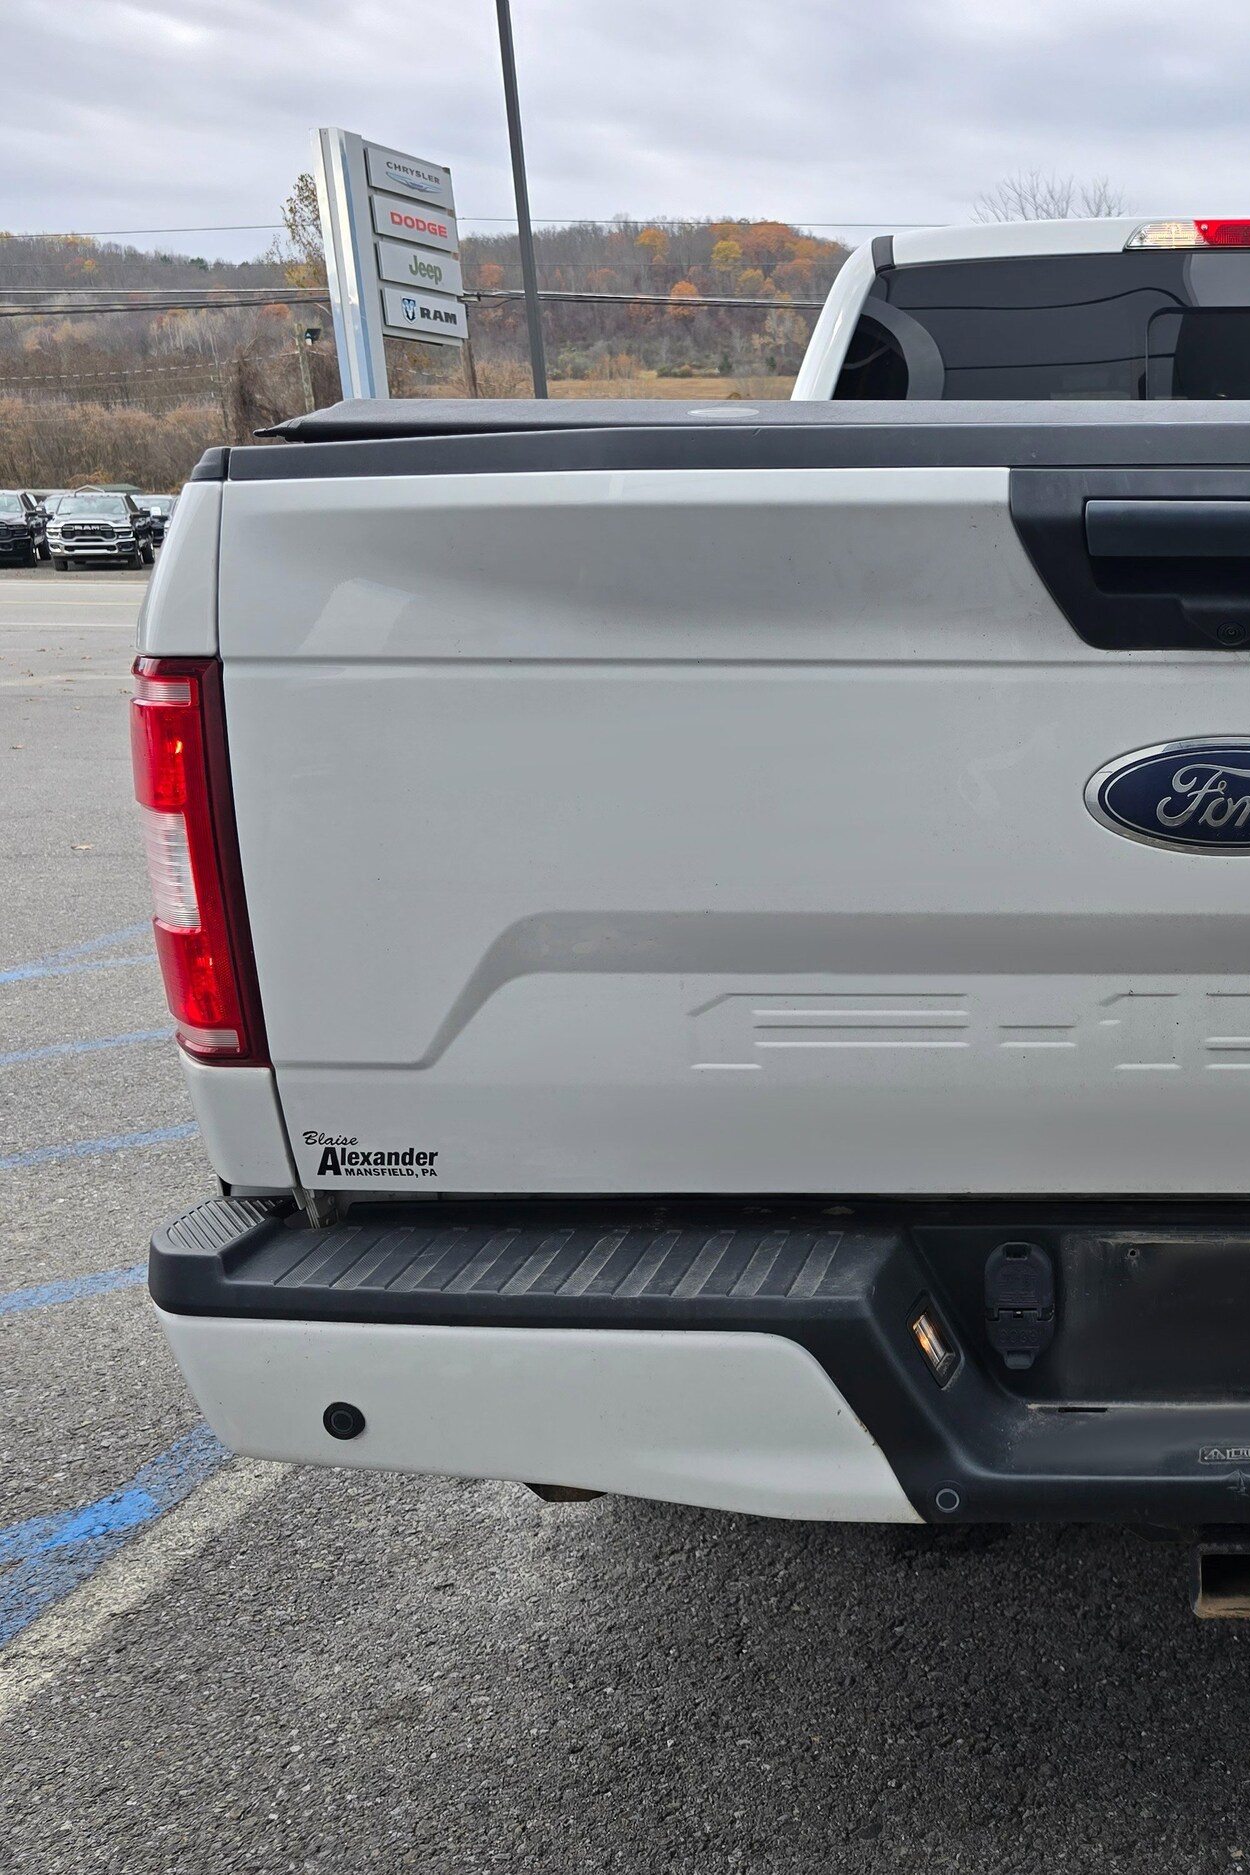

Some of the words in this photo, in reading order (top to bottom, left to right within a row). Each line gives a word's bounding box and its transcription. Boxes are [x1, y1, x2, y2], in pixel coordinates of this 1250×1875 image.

[386, 161, 441, 185] CHRYSLER
[390, 211, 448, 239] DODGE
[409, 255, 443, 285] Jeep
[420, 306, 457, 325] RAM
[302, 1131, 358, 1146] Blaise
[317, 1147, 439, 1176] Alexander
[344, 1168, 419, 1178] MANSFIELD,
[421, 1168, 438, 1177] PA
